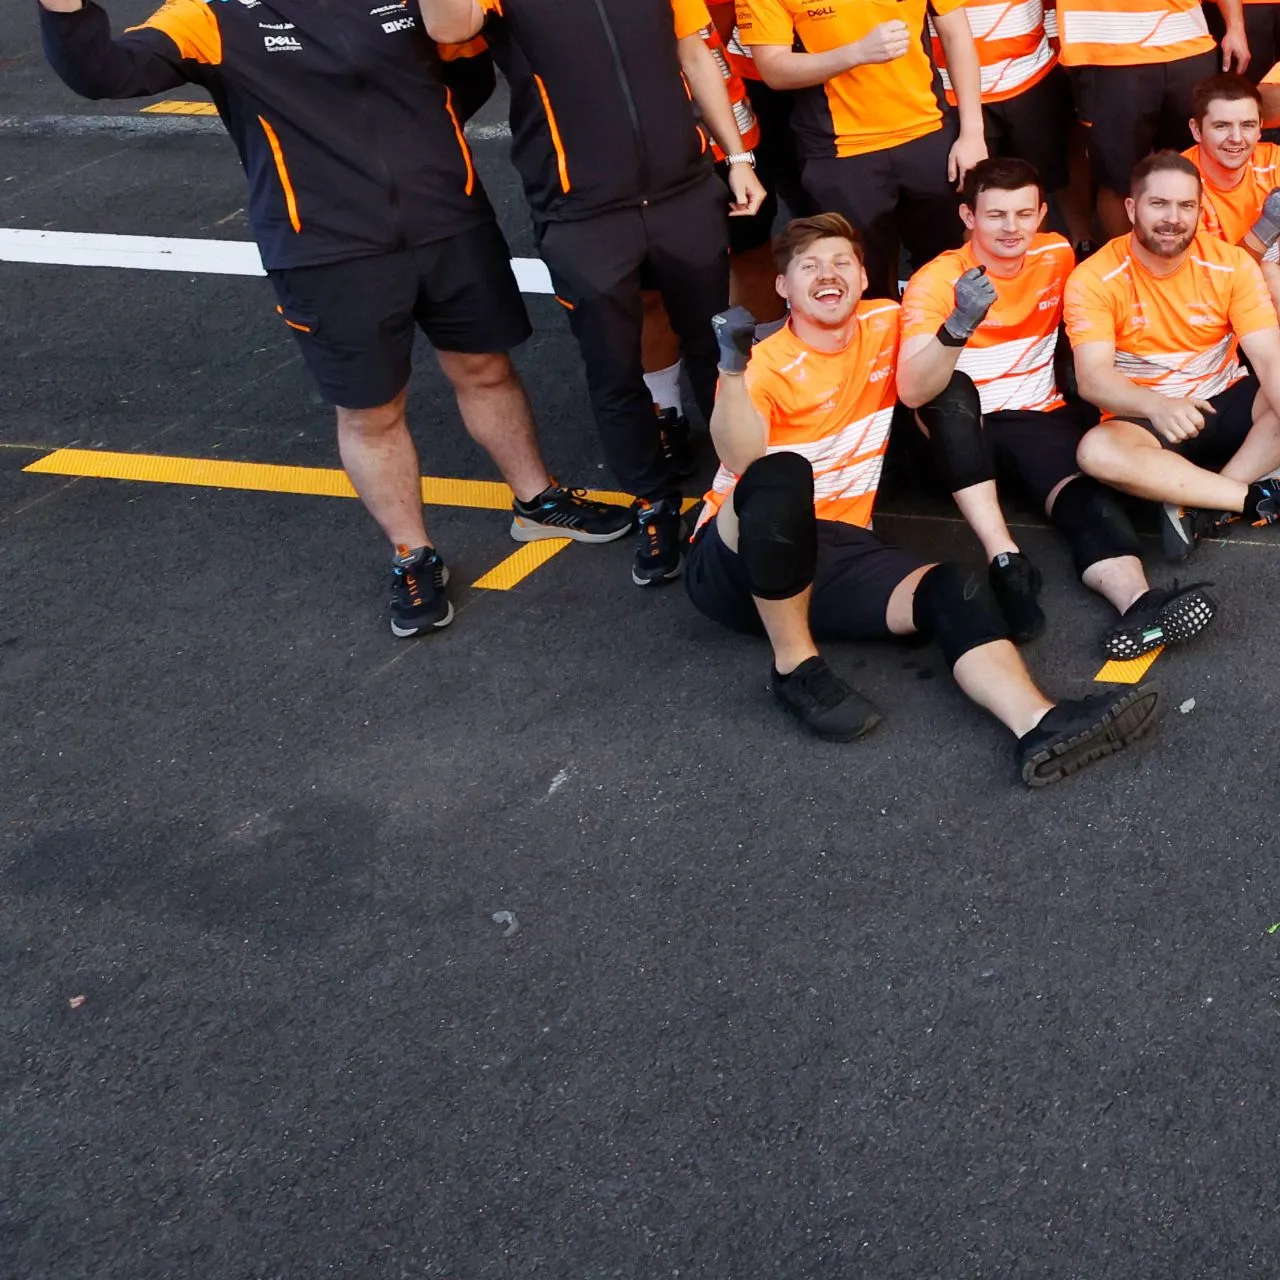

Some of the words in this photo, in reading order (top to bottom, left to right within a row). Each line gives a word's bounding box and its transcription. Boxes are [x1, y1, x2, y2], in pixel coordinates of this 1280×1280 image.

[807, 6, 836, 19] DELL
[381, 16, 416, 34] OKX
[264, 35, 301, 47] DELL
